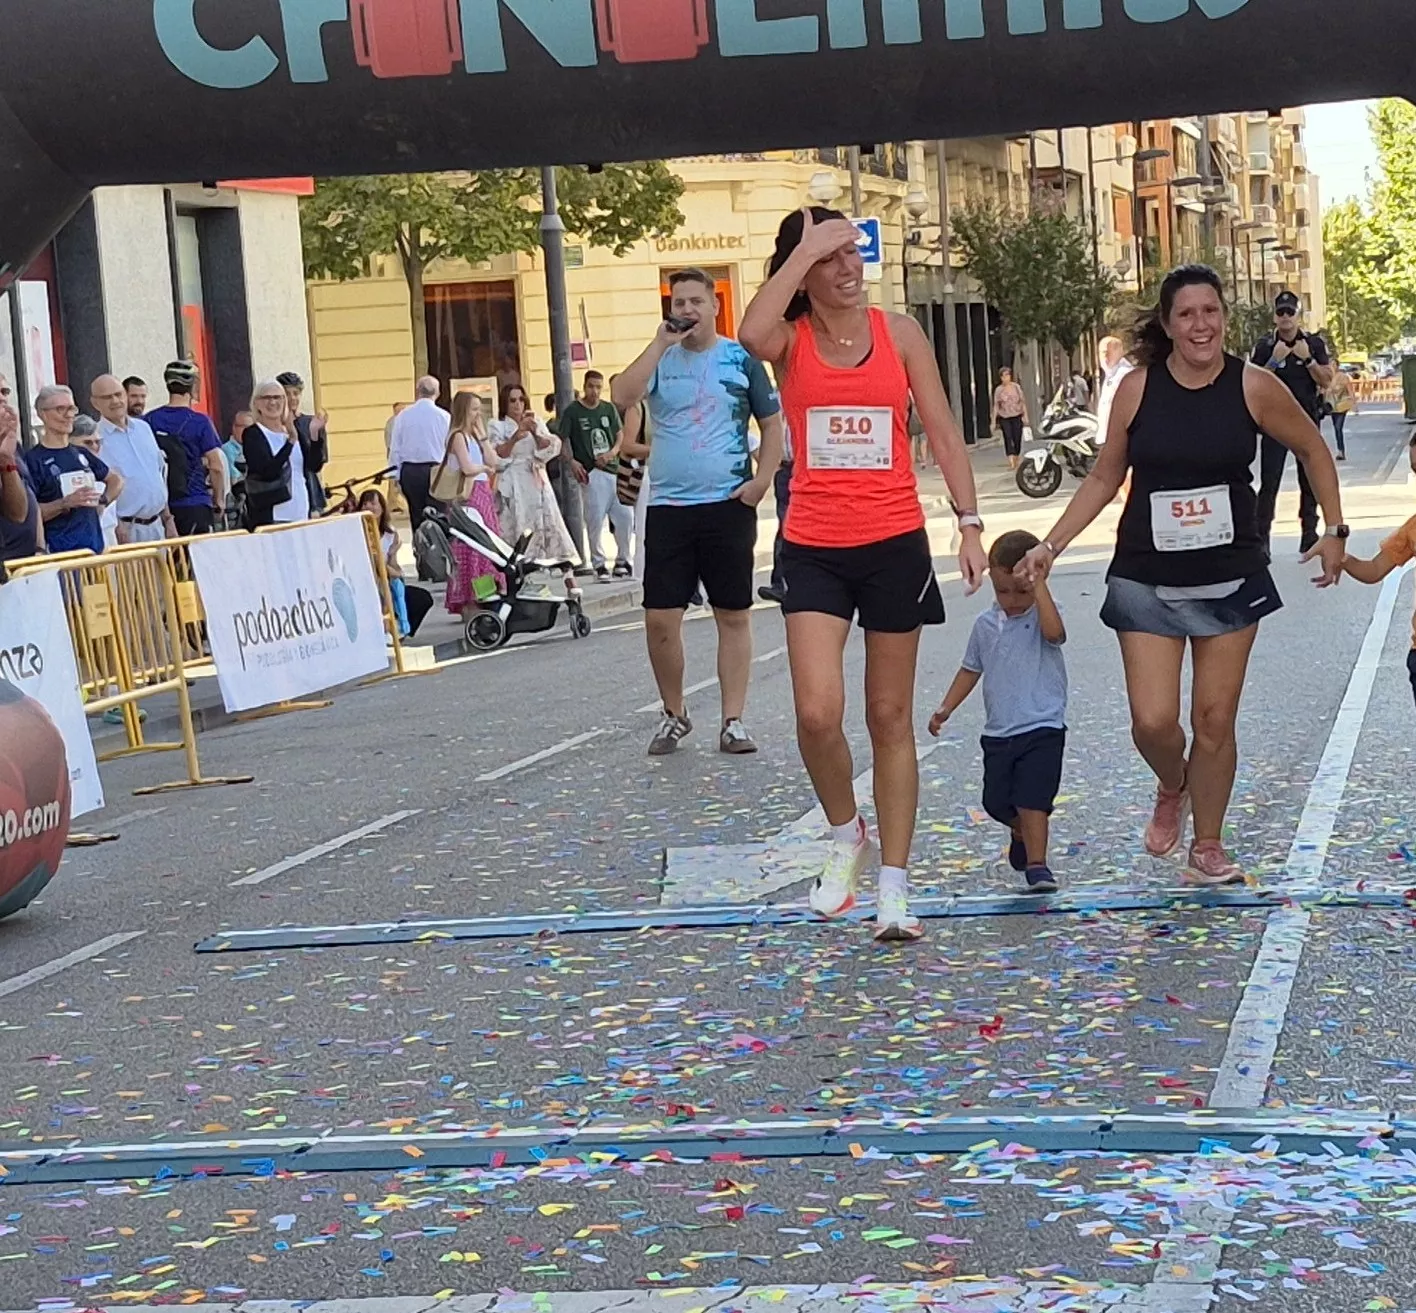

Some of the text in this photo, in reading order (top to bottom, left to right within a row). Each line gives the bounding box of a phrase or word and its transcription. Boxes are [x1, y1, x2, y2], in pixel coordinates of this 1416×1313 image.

[829, 416, 873, 435] 510
[1170, 497, 1213, 518] 511
[232, 588, 335, 672] podoactiva
